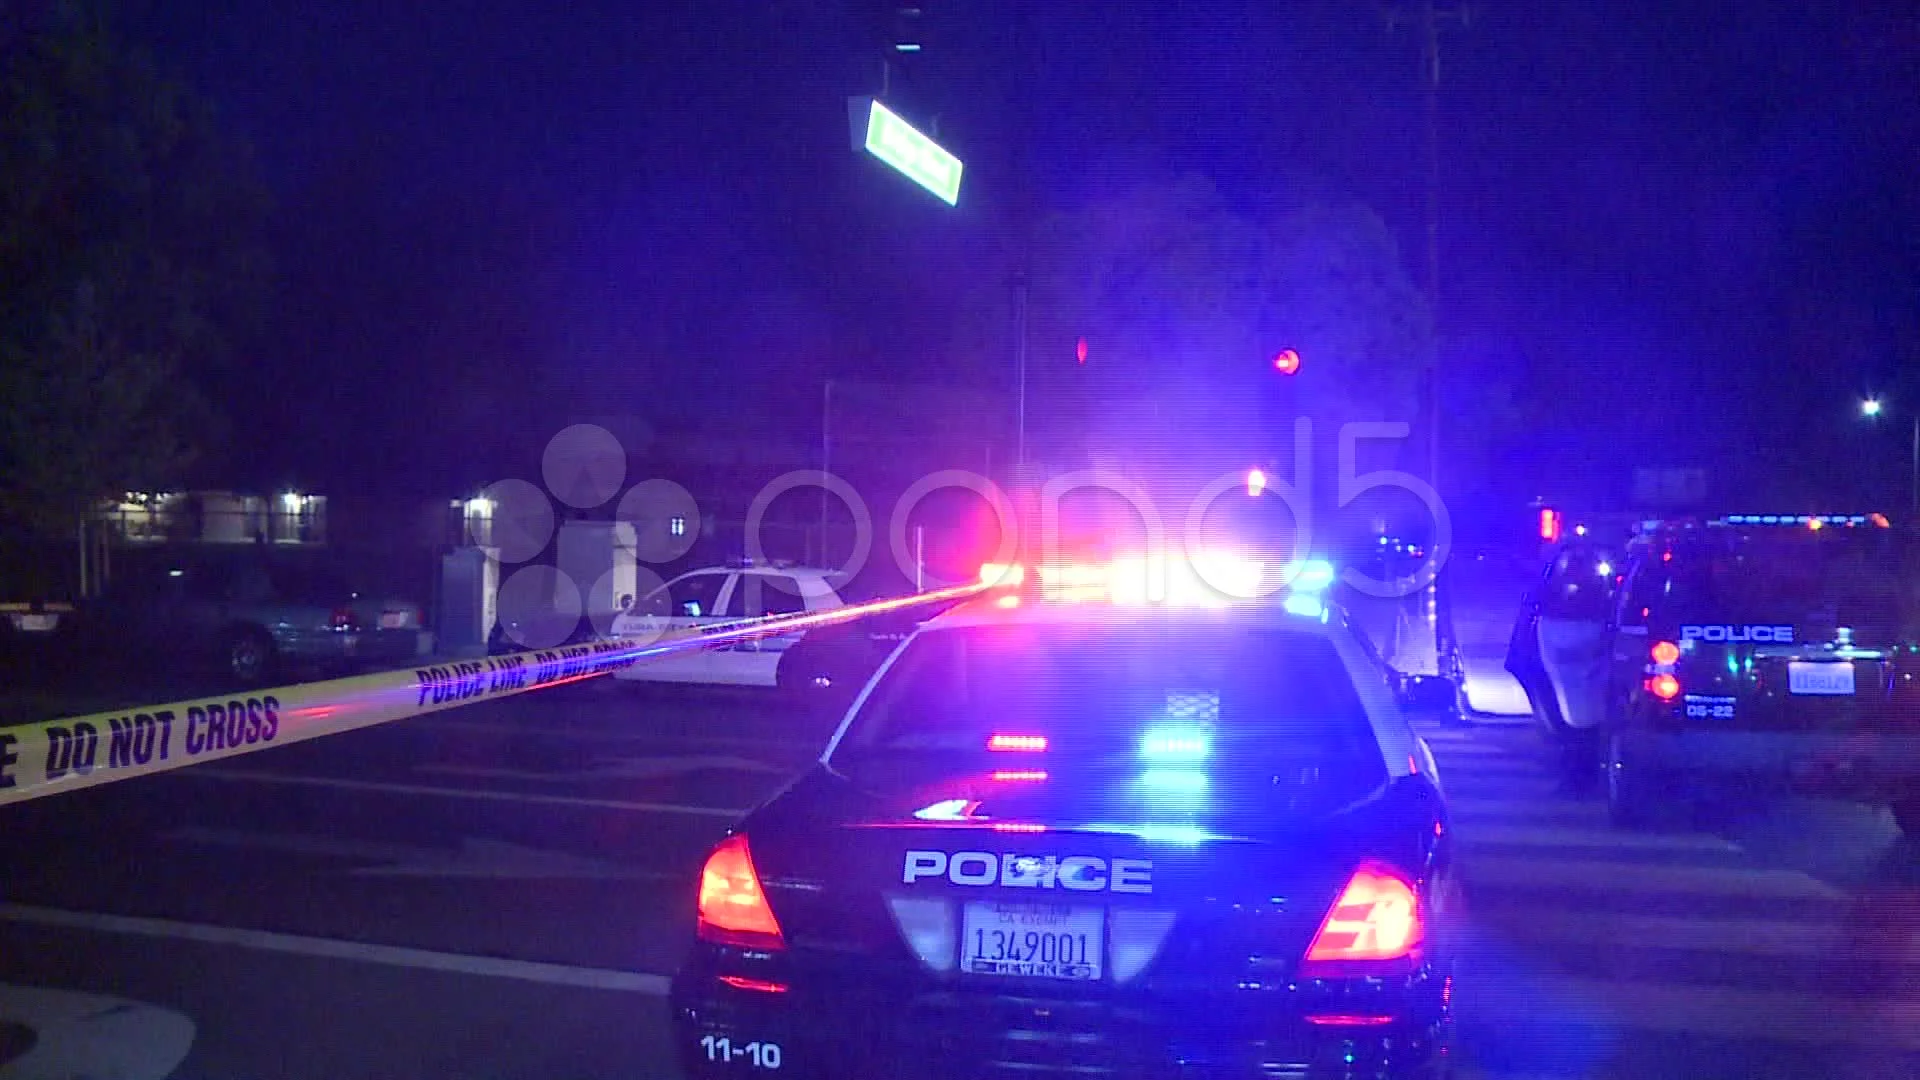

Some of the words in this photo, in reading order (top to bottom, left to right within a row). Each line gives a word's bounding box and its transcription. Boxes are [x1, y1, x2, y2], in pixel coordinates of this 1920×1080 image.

[1681, 625, 1793, 642] POLICE
[45, 722, 98, 780] DO
[108, 711, 175, 769] NOT
[185, 695, 280, 756] CROSS
[903, 850, 1153, 894] POLICE
[976, 928, 1090, 964] 1349001
[700, 1035, 781, 1069] 11-10
